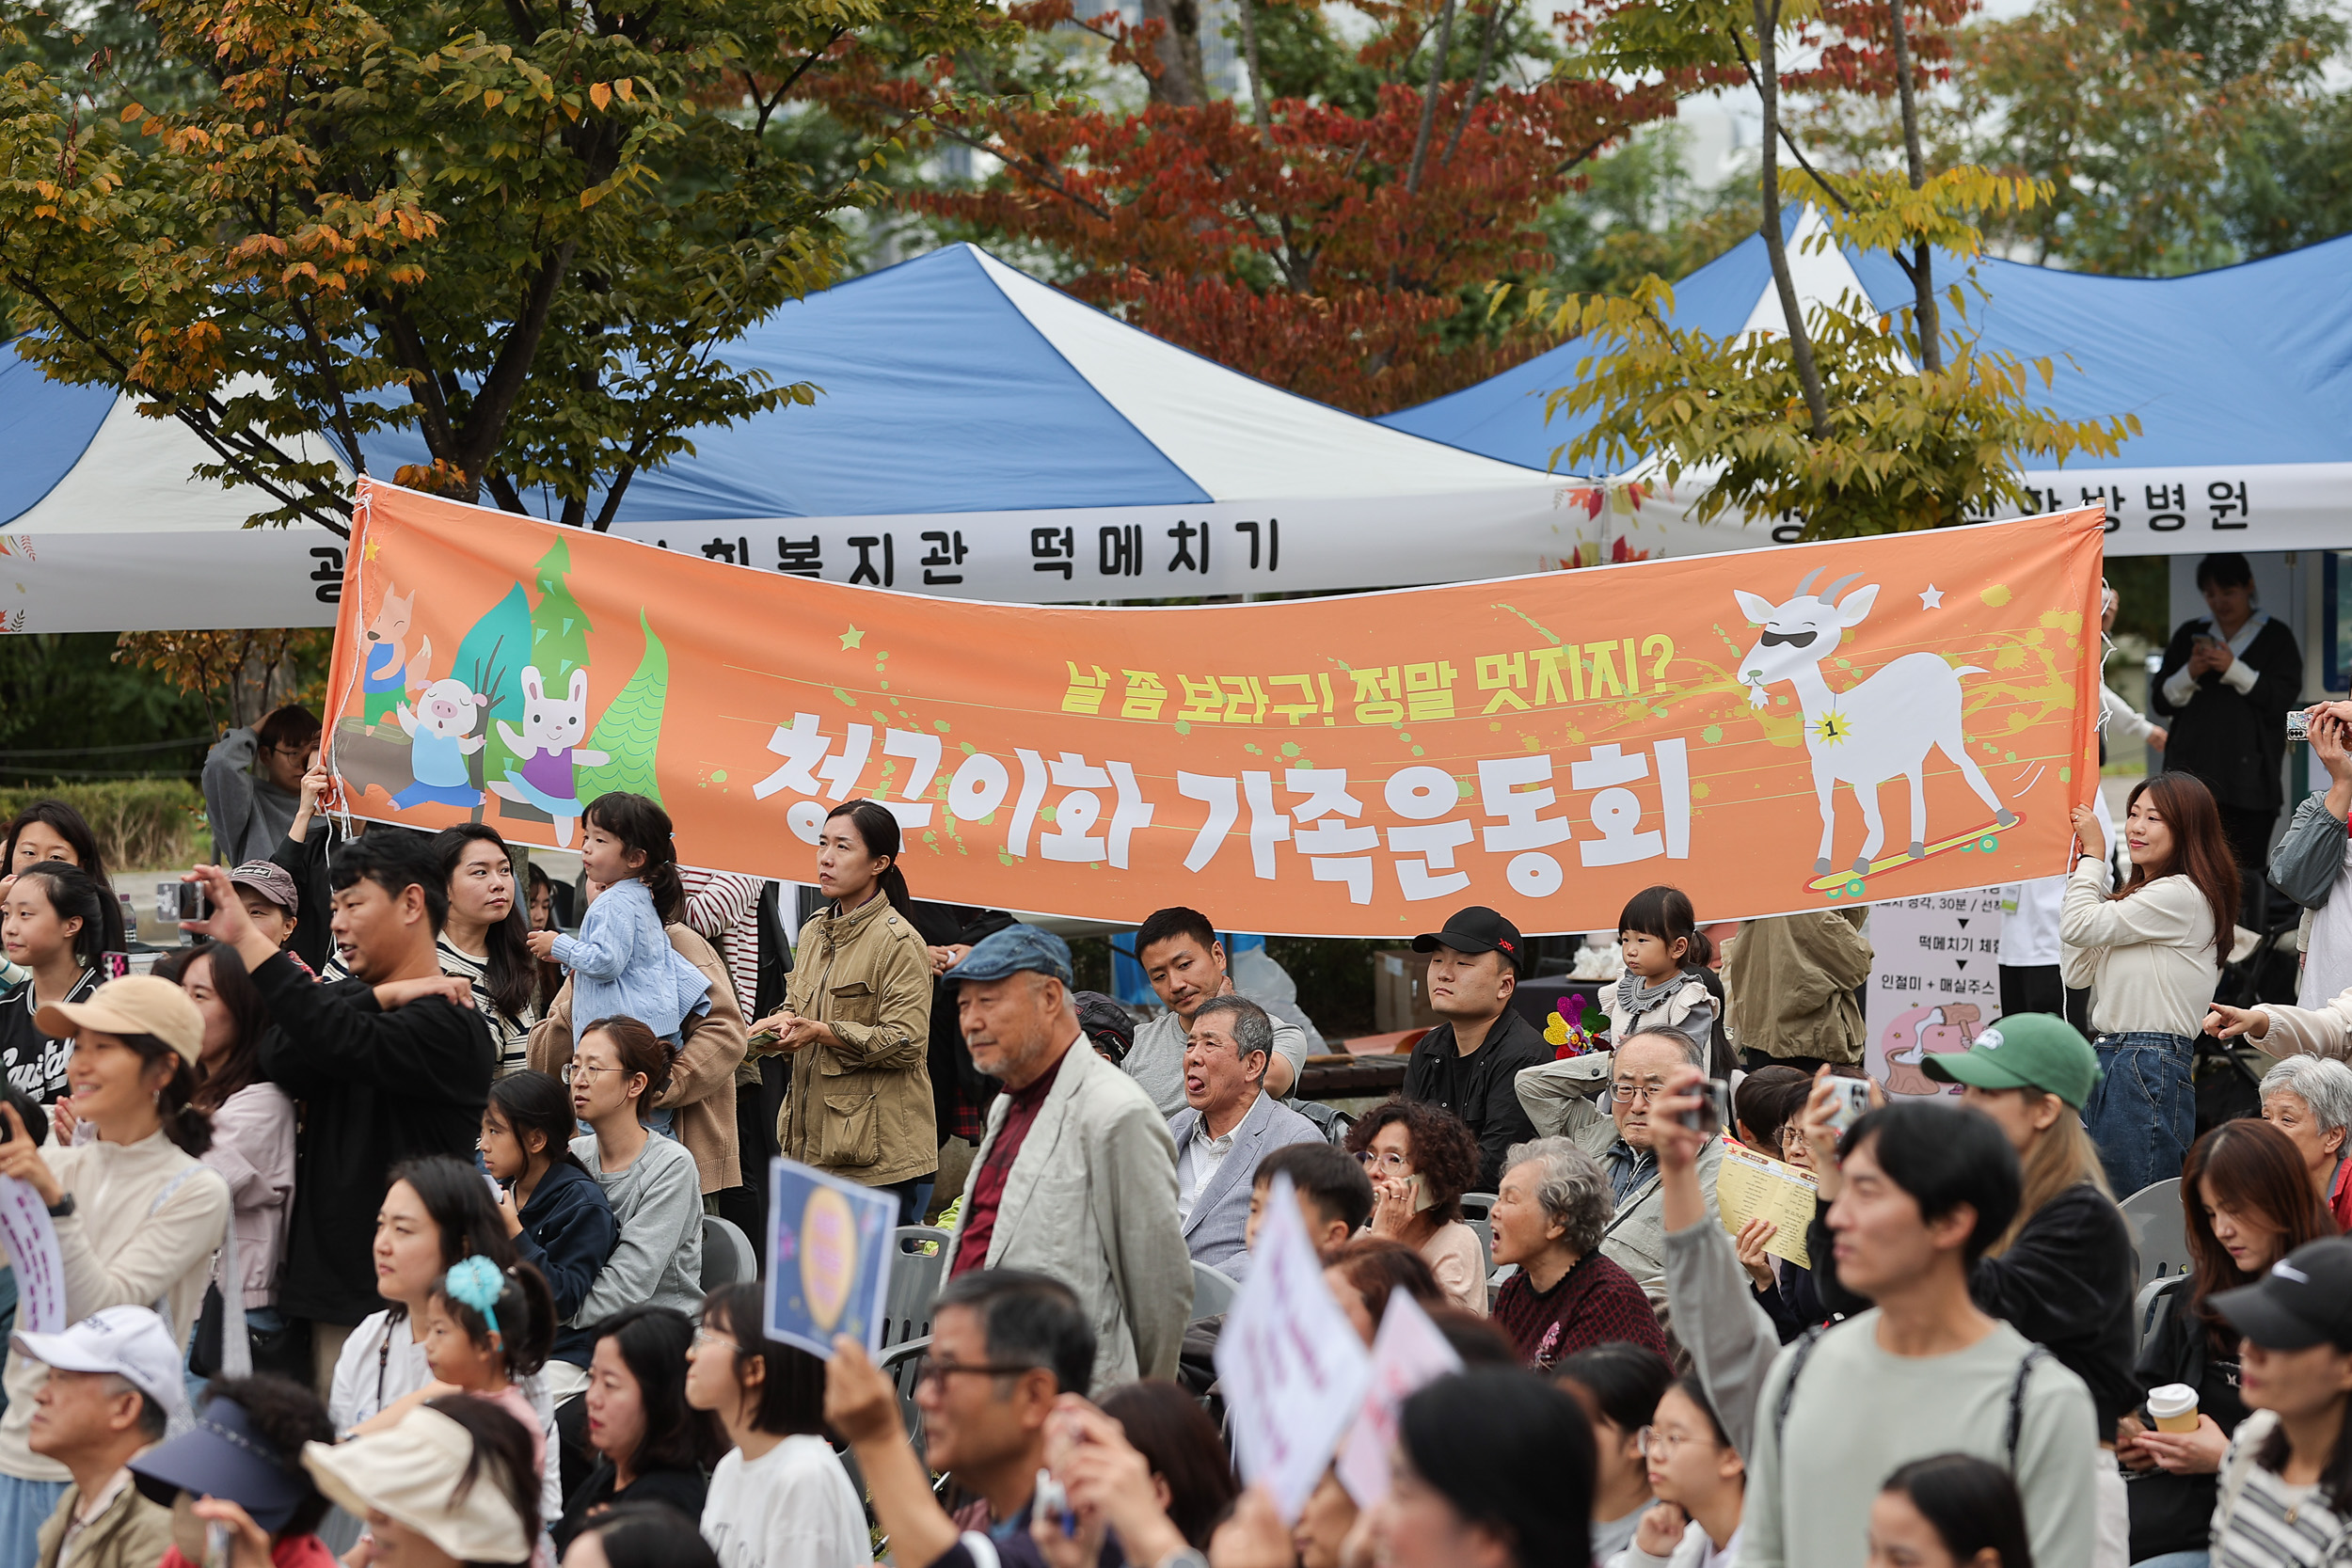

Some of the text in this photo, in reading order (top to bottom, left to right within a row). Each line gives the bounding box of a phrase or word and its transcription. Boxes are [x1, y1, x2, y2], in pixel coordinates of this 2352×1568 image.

[1031, 518, 1279, 580] 떡메치기
[1061, 633, 1675, 726] 날 좀 보라구! 정말 멋지지?
[1825, 721, 1838, 736] 1
[752, 711, 1691, 906] 청구이화 가족운동회
[1939, 897, 1966, 911] 30분
[1919, 935, 1974, 952] 떡메치기
[1882, 974, 1921, 990] 인절미
[1940, 977, 1994, 994] 매실주스
